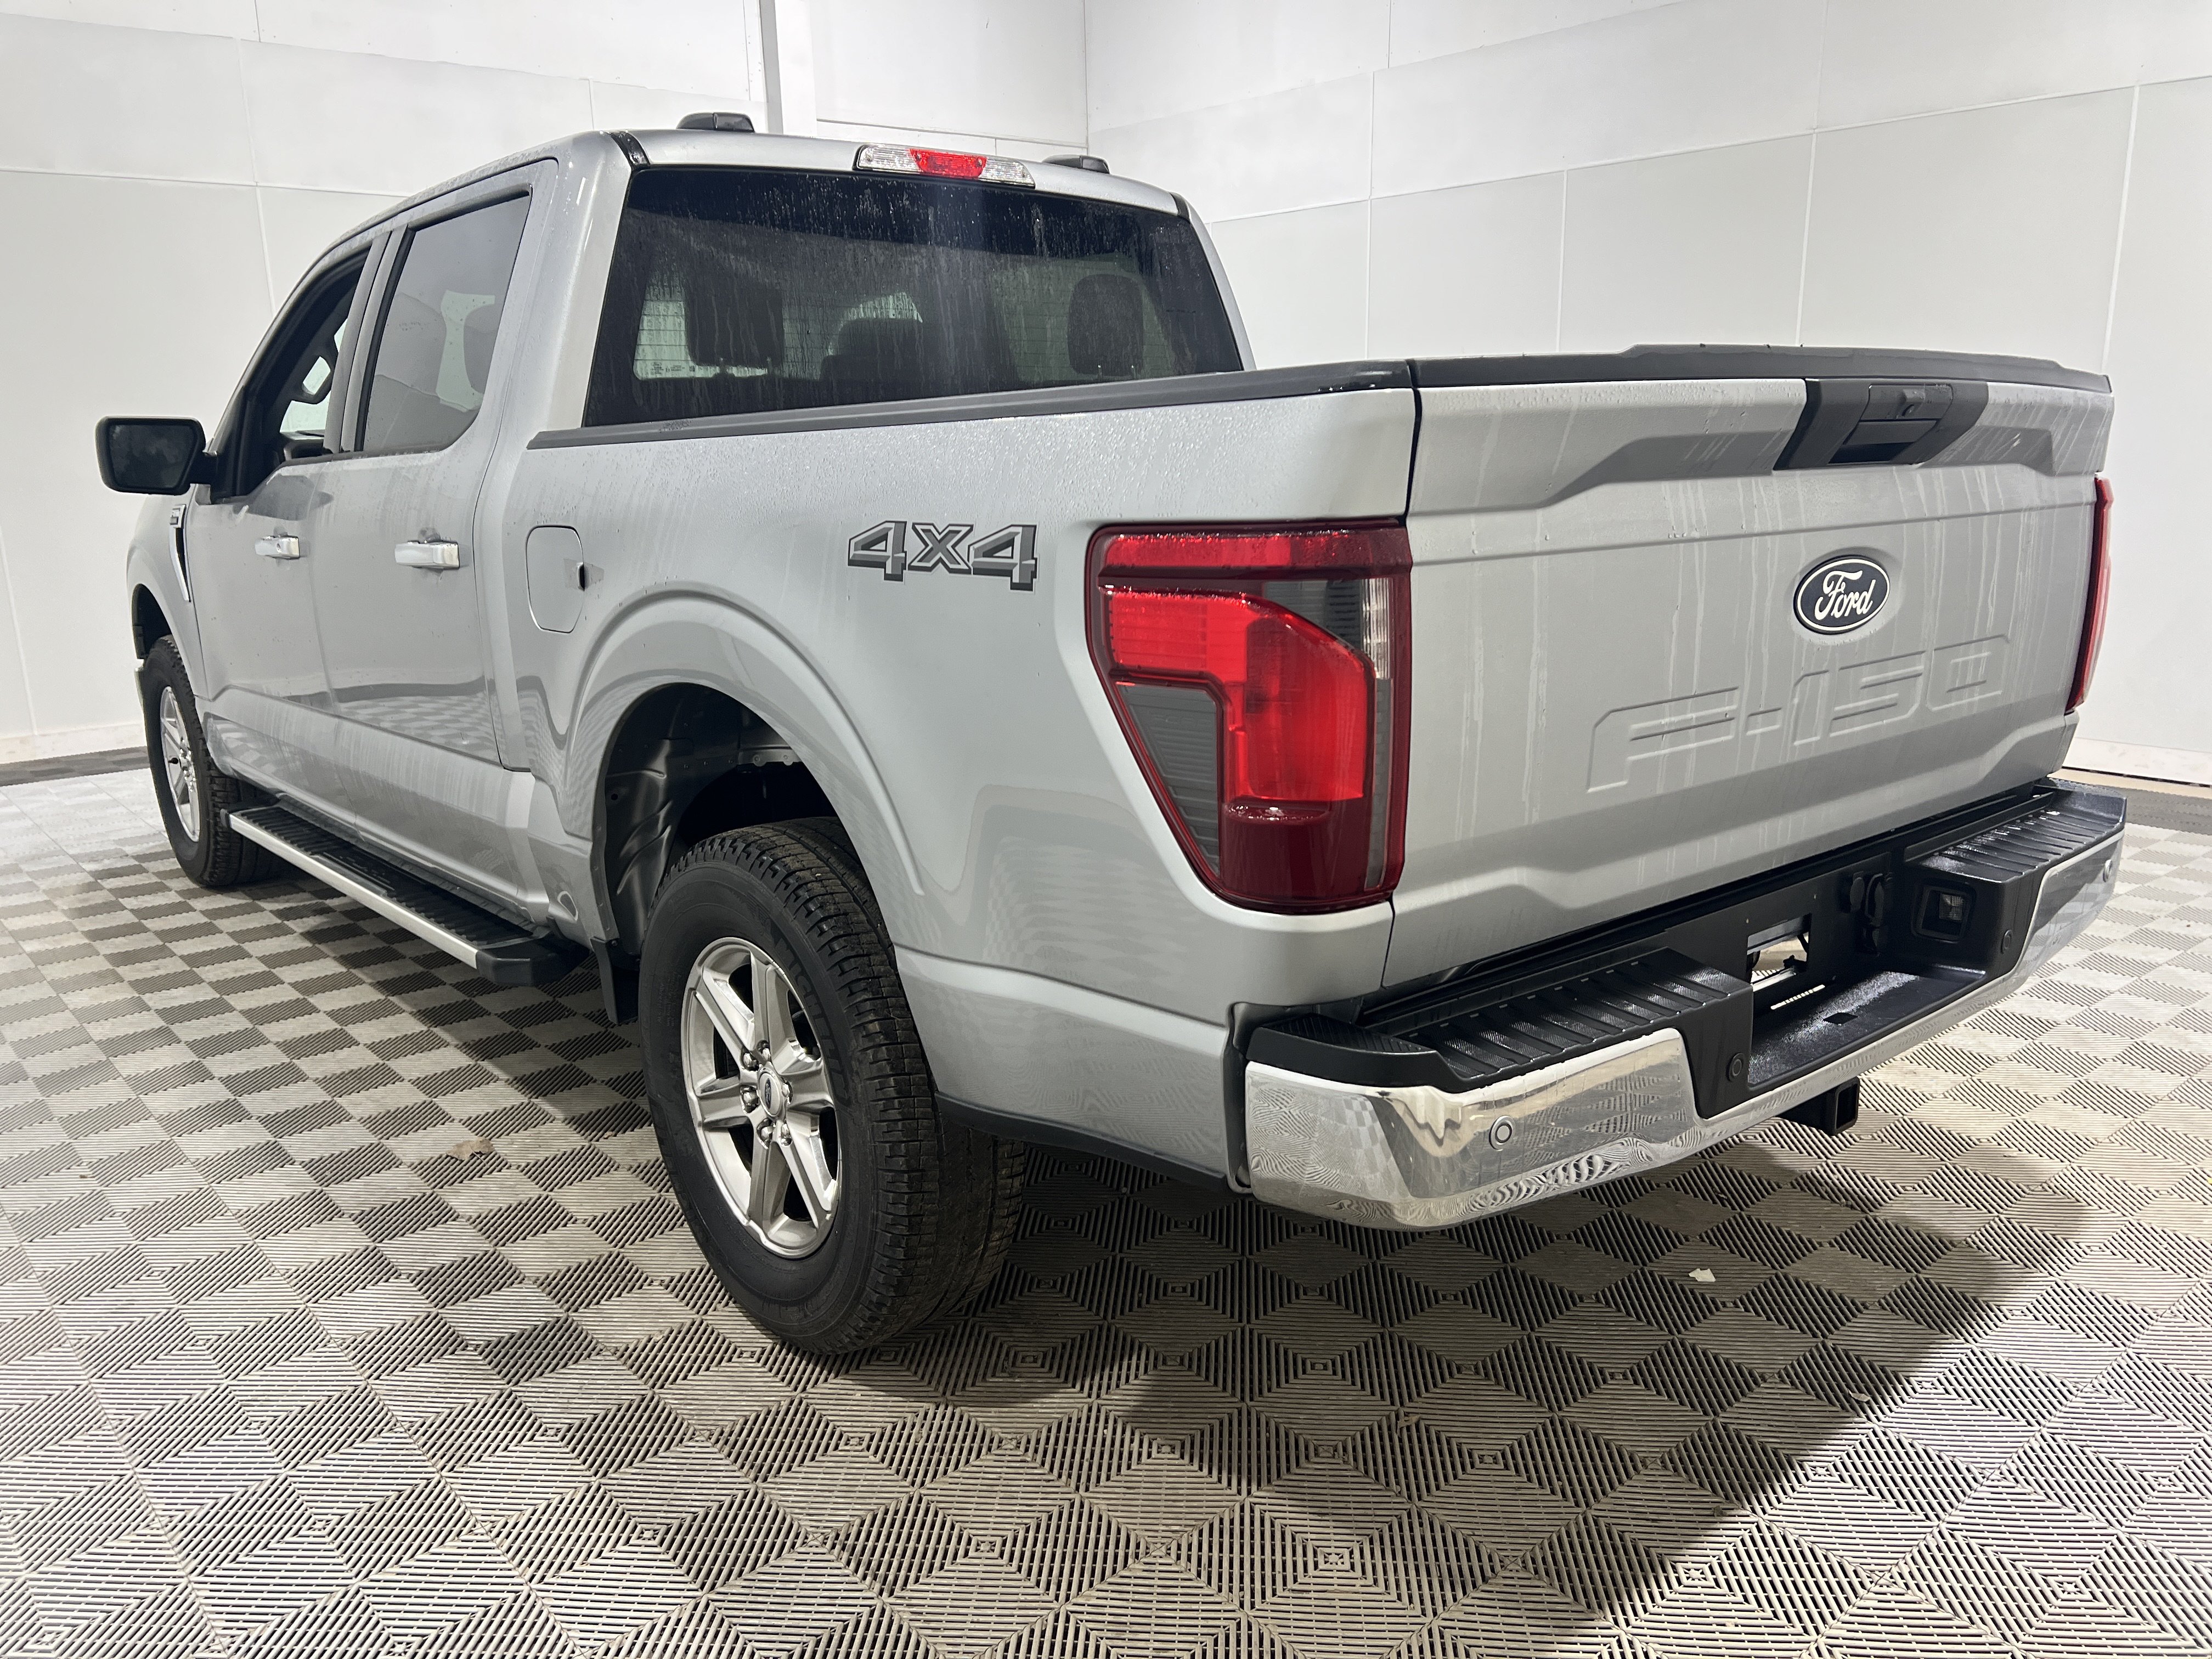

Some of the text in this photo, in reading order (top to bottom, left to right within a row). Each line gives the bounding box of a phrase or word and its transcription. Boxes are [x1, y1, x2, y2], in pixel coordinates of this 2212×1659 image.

[1815, 571, 1876, 620] Ford
[1586, 634, 2010, 793] F-150
[775, 936, 845, 1101] MICHELIN
